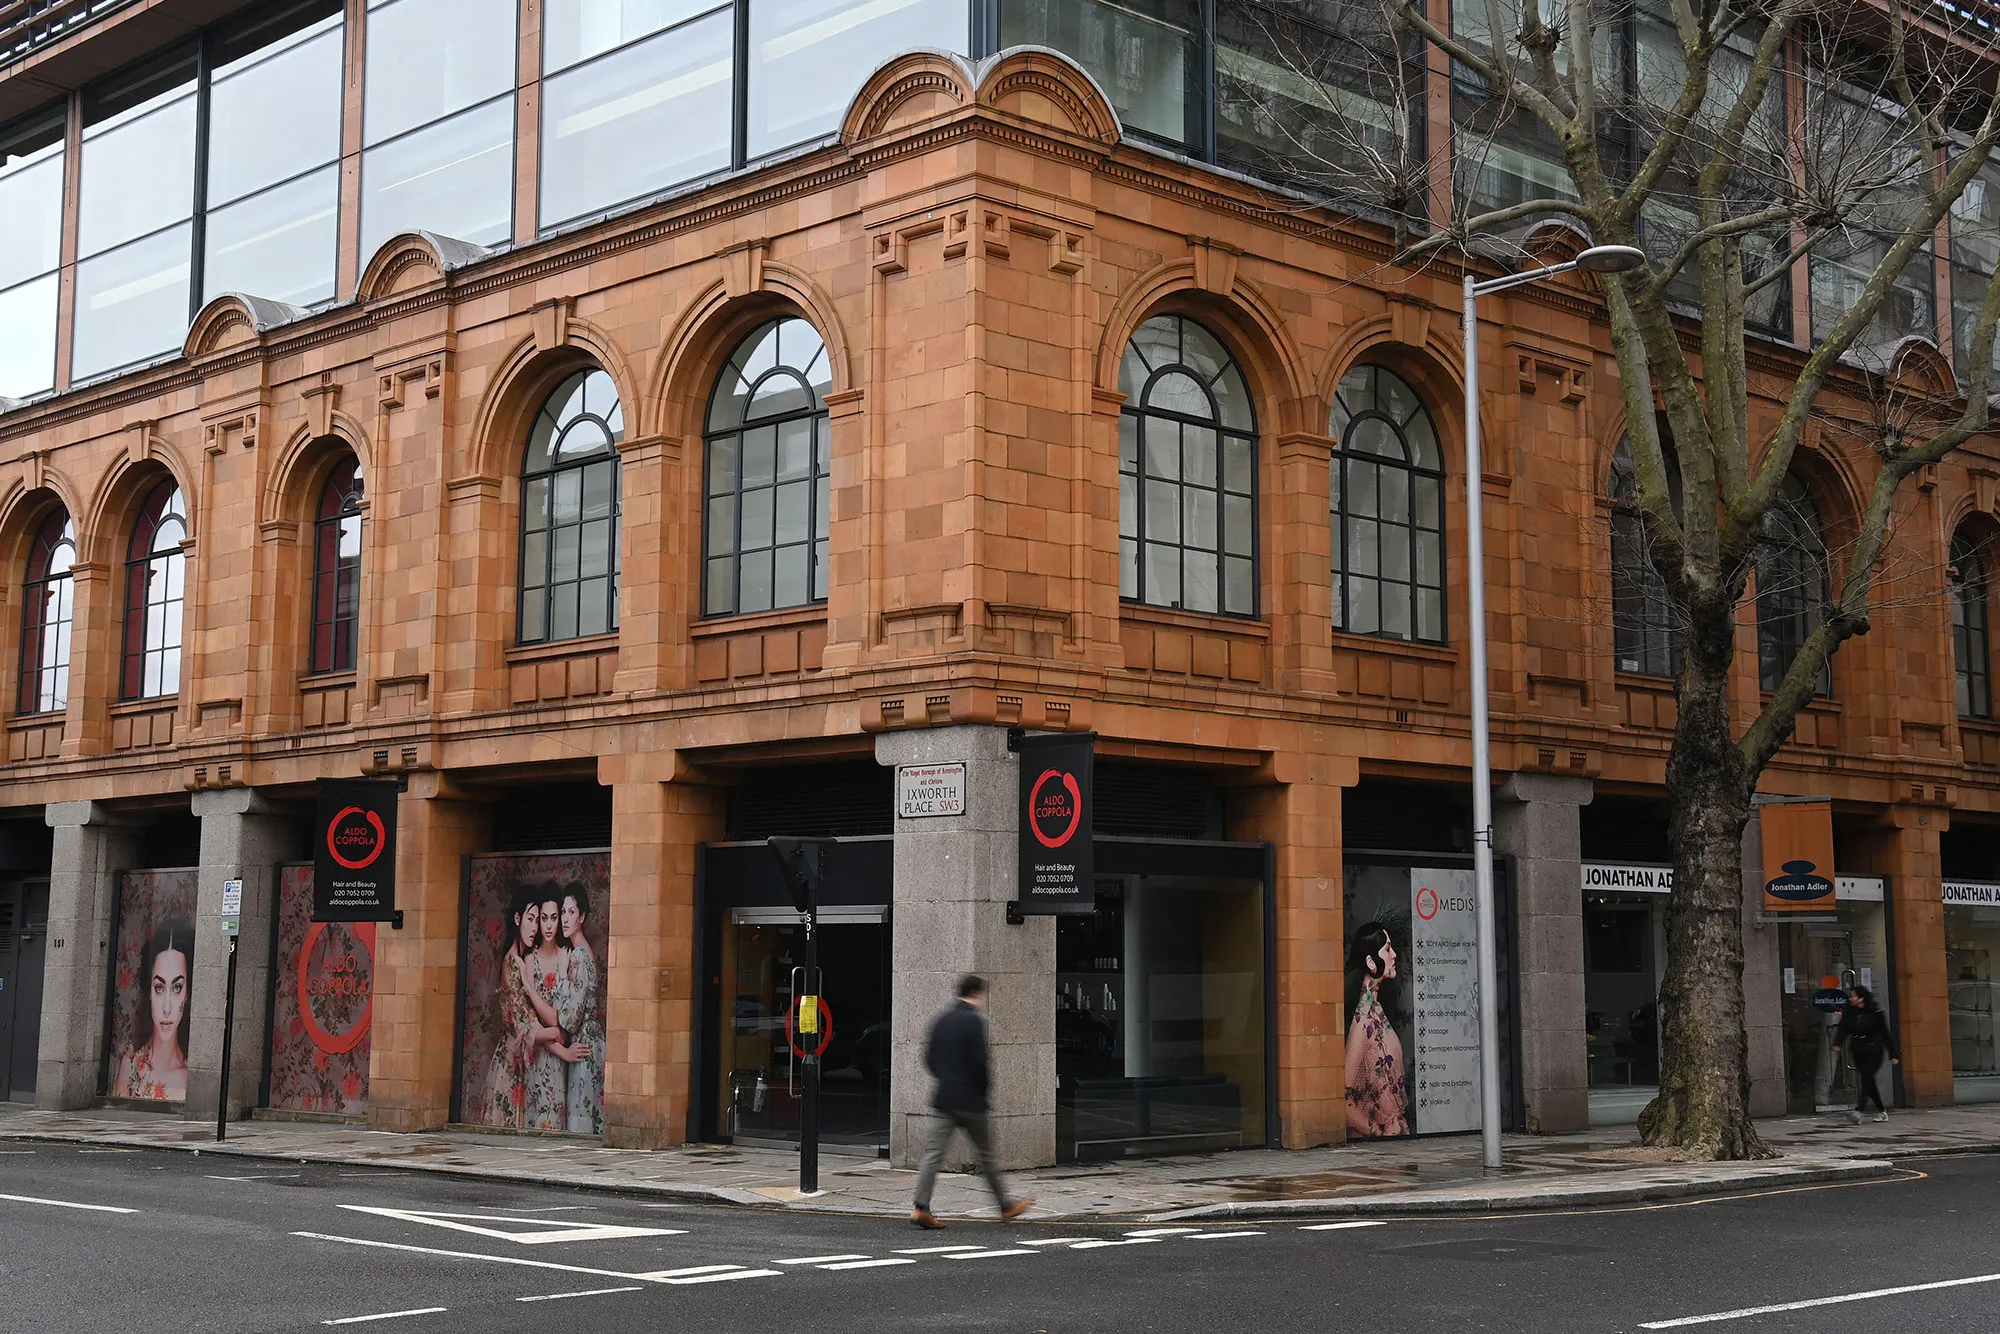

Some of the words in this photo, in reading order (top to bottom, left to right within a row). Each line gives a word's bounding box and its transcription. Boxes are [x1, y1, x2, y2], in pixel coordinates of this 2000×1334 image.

[907, 786, 957, 801] IXWORTH
[1043, 795, 1065, 806] ALDO
[1036, 807, 1072, 818] COPPOLA
[344, 828, 368, 836] ALDO
[335, 836, 375, 845] COPPOLA
[1034, 864, 1047, 872] Hair
[1047, 863, 1056, 871] and
[1057, 863, 1075, 873] Beauty
[1036, 875, 1047, 883] 020
[1047, 875, 1060, 883] 7052
[1060, 874, 1074, 882] 0709
[1586, 868, 1653, 888] JONATHAN
[357, 881, 377, 889] Beauty
[1771, 883, 1805, 892] Jonathan
[1806, 882, 1828, 891] Adler
[1032, 886, 1079, 895] aldocoppola.co.uk
[1942, 886, 1992, 902] JONATHAN
[1439, 898, 1474, 911] MEDIS
[54, 939, 65, 948] 151
[322, 955, 357, 973] ALDO
[310, 976, 369, 995] COPPOLA
[1427, 992, 1457, 1000] Mesotherapy
[1814, 996, 1834, 1004] Jonathan
[1428, 1028, 1449, 1036] Massage
